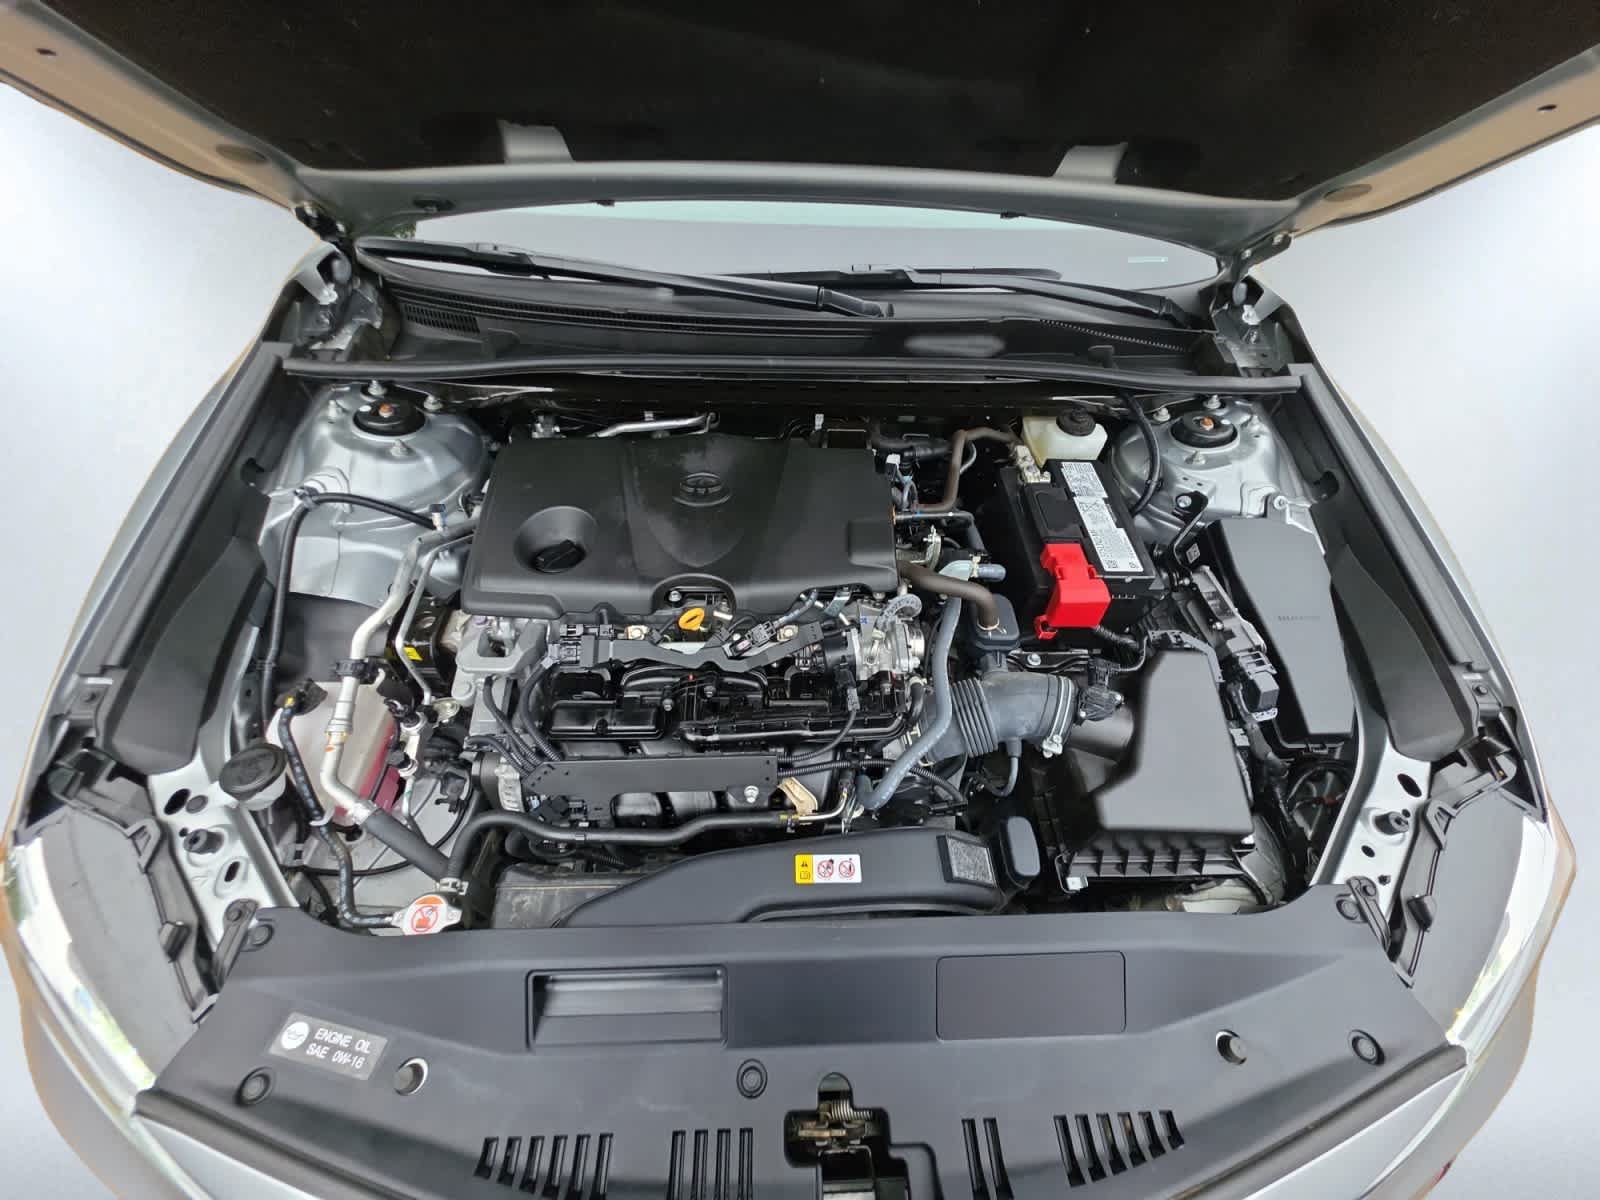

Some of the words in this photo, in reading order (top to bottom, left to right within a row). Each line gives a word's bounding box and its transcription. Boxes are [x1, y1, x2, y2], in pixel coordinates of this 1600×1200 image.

[314, 1028, 352, 1047] ENGINE
[355, 1039, 371, 1055] OIL
[306, 1043, 330, 1059] SAE
[332, 1050, 365, 1069] 0W-16
